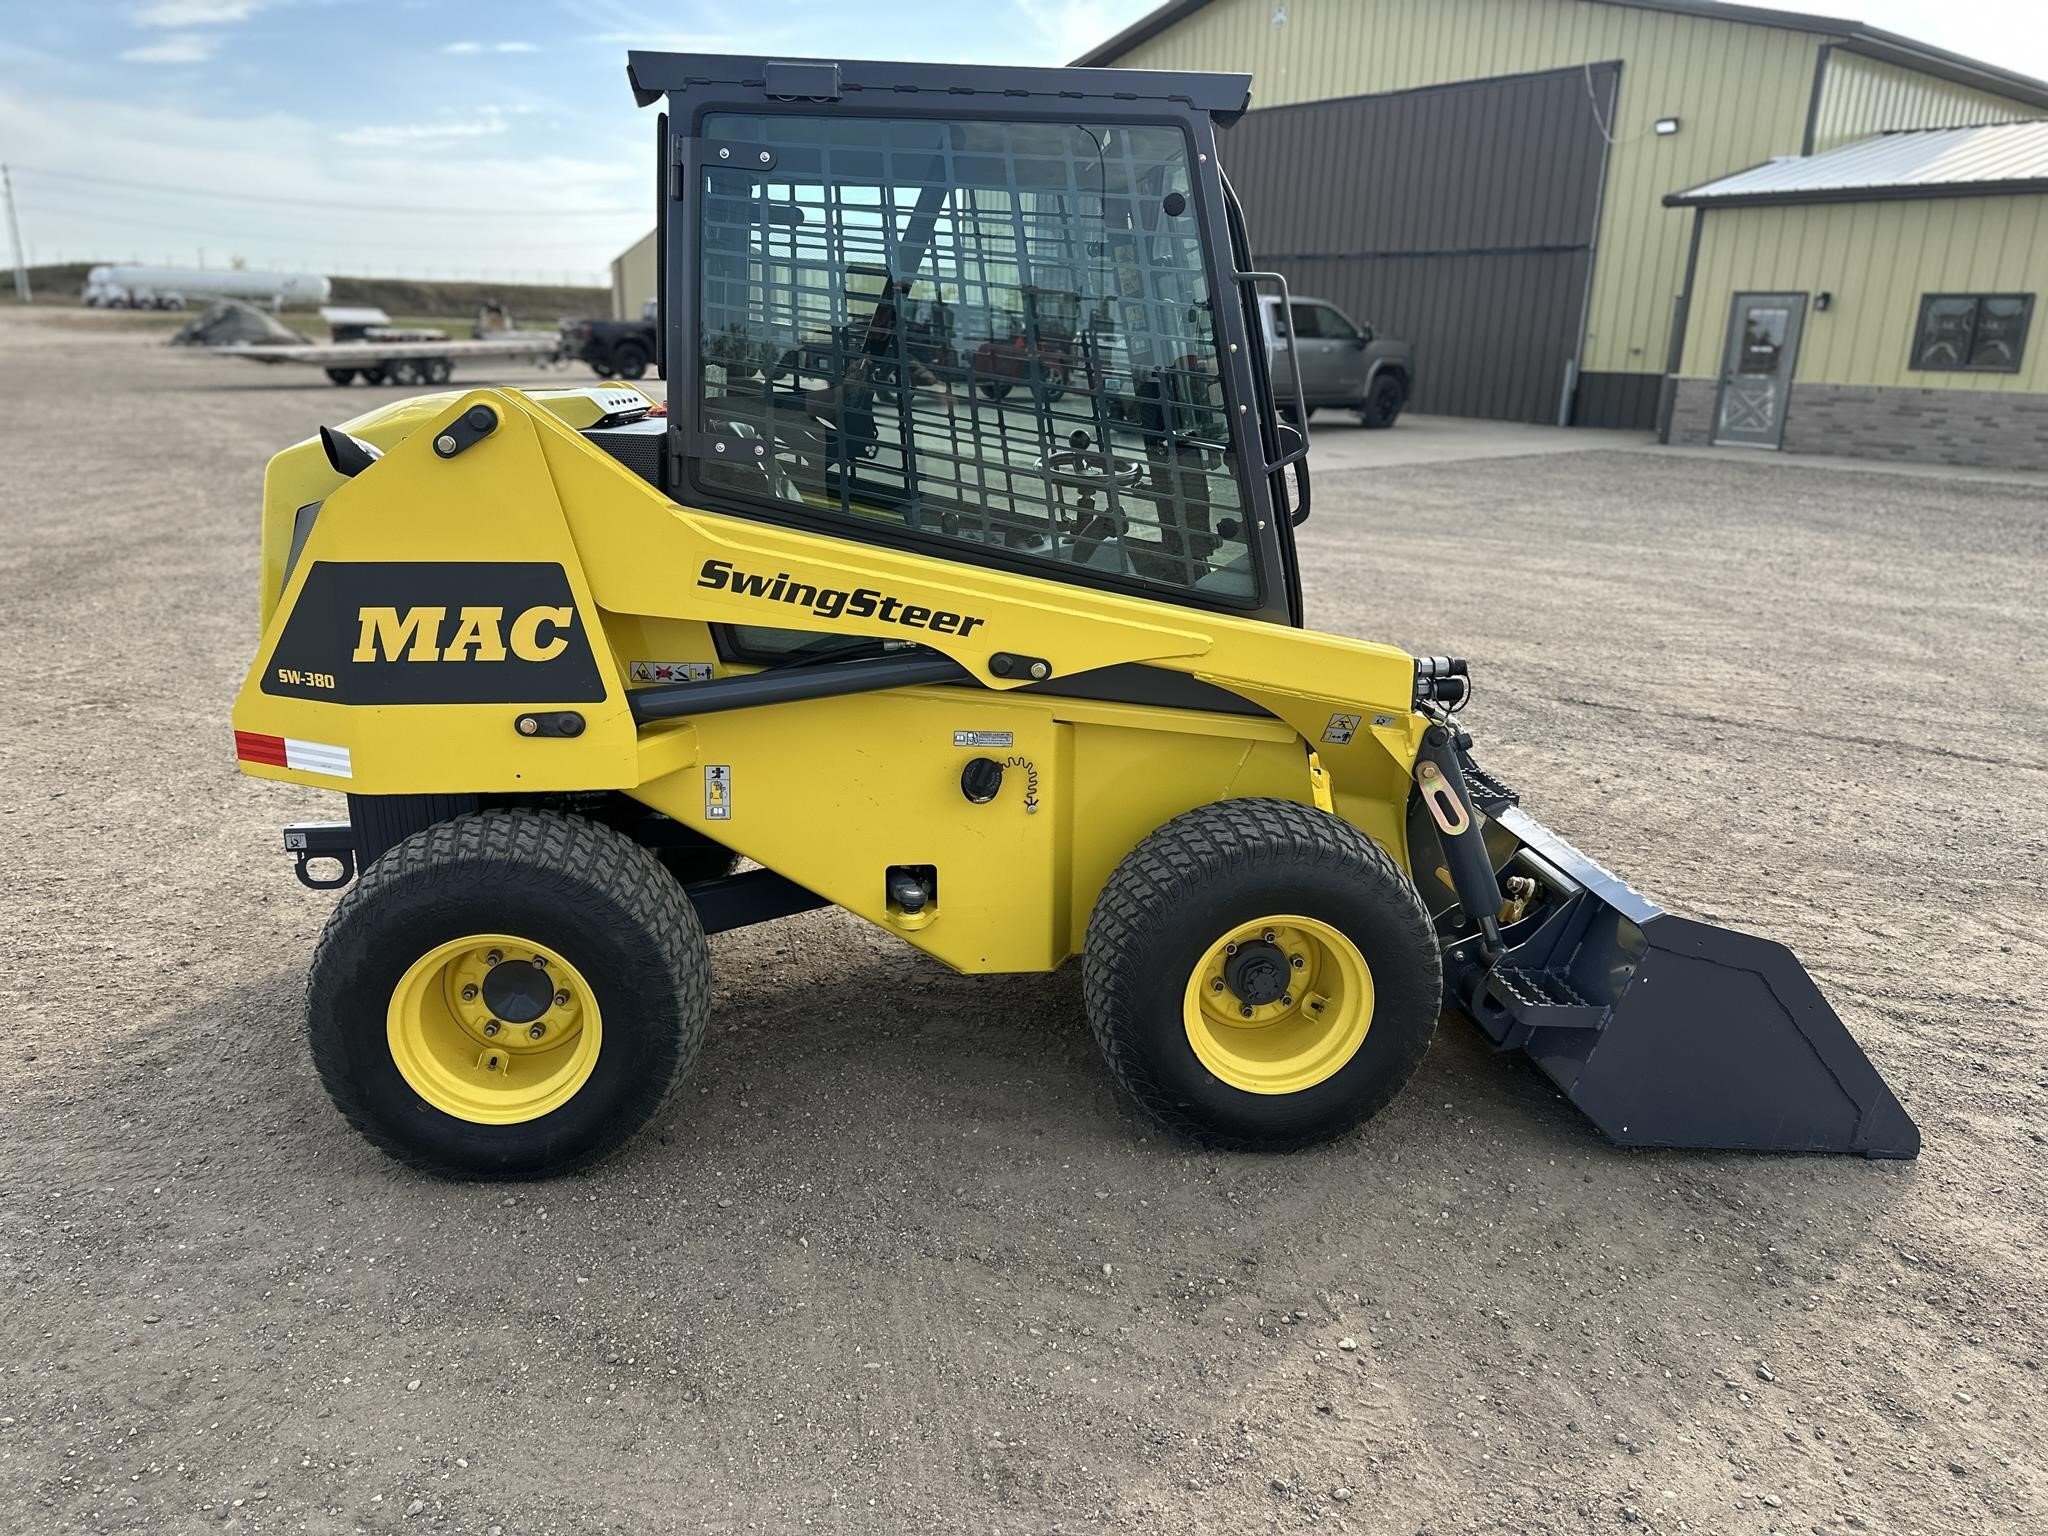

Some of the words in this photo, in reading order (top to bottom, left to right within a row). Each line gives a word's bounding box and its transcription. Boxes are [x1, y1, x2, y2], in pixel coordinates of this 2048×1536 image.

[697, 559, 985, 637] SwingSteer
[352, 605, 574, 663] MAC
[278, 669, 335, 689] SW-380
